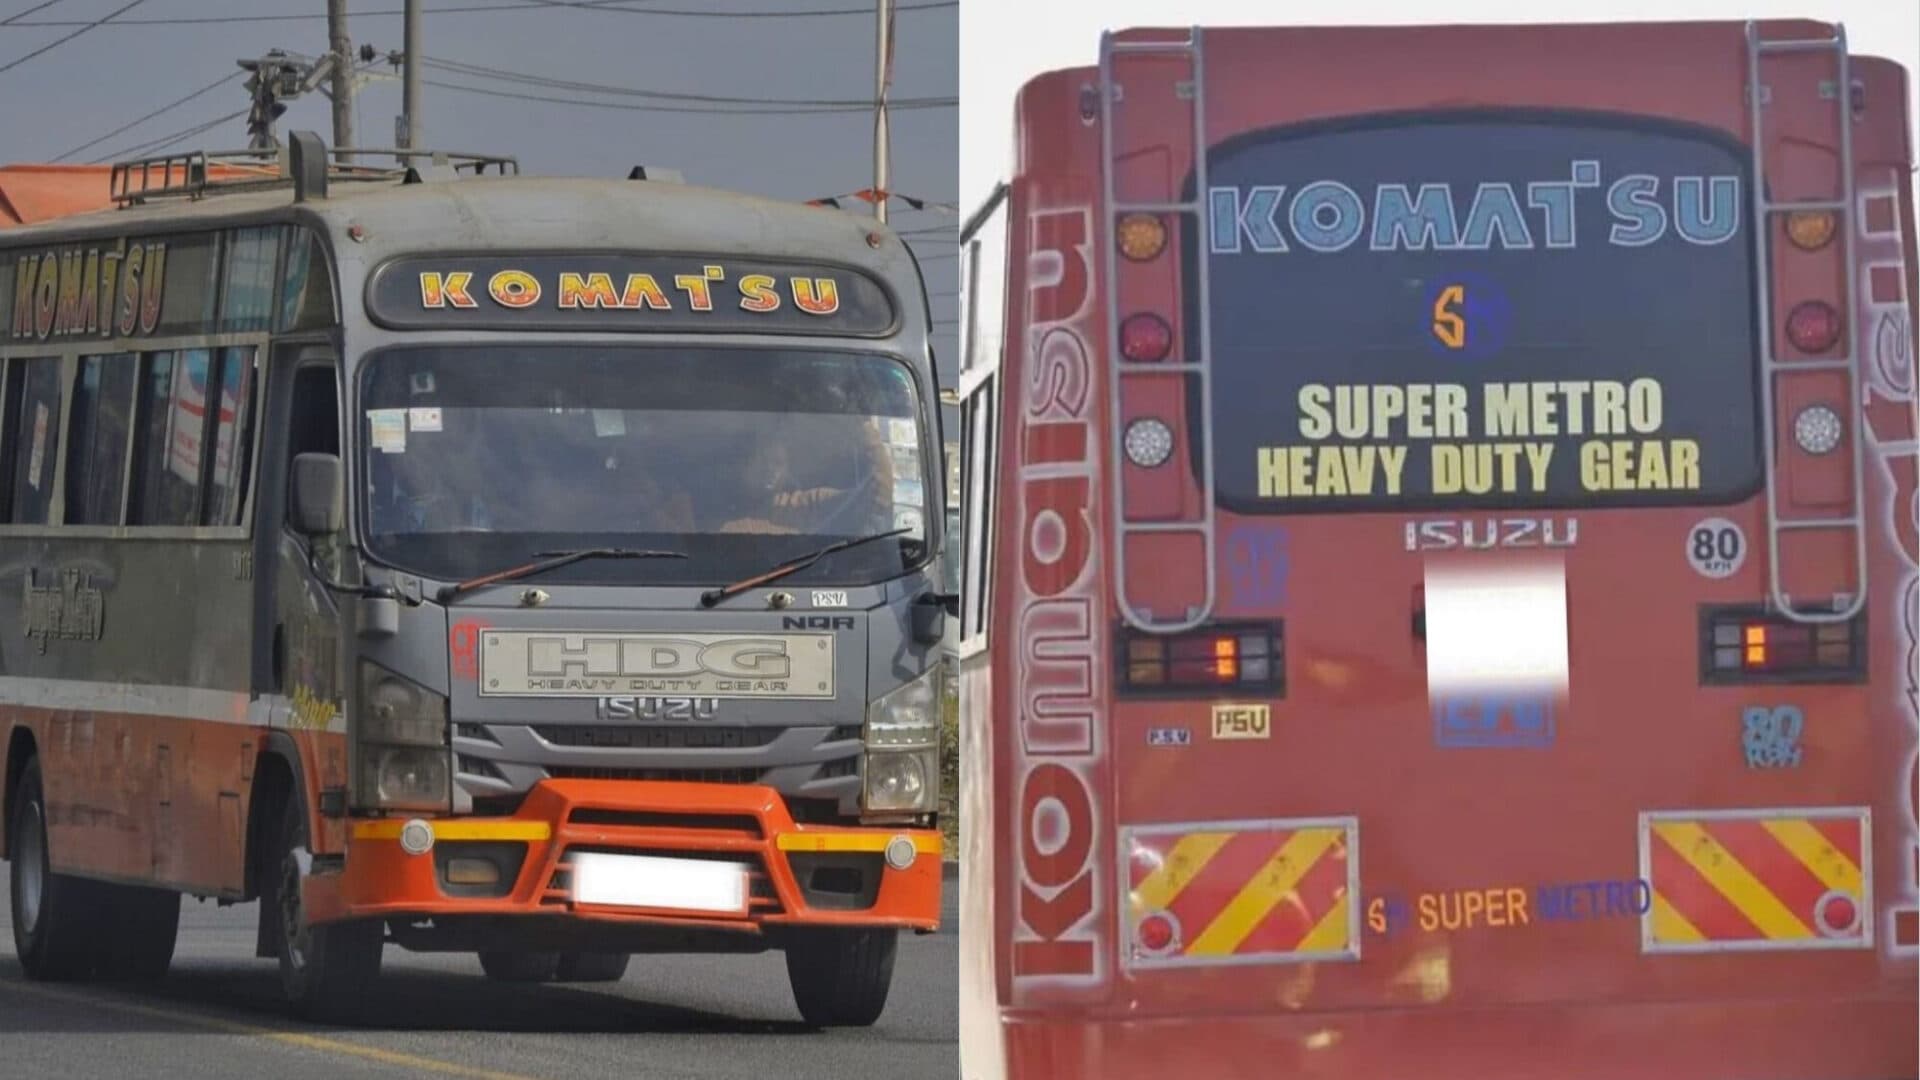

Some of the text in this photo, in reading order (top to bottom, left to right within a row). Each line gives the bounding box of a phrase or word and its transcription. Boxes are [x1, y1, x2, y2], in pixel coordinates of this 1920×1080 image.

[1207, 160, 1741, 255] KOMATSU
[12, 237, 166, 340] KOMATSU
[420, 264, 840, 315] KOMATSU
[1298, 377, 1663, 440] SUPER METRO
[1257, 439, 1701, 498] HEAVY DUTY GEAR
[1404, 517, 1579, 552] ISUZU
[1693, 527, 1740, 561] 80
[782, 615, 855, 631] NQR
[527, 637, 791, 679] HDG
[527, 679, 789, 692] HEAVY DUTY GEAR
[596, 696, 720, 721] ISUZU
[1215, 708, 1267, 735] PSV
[1418, 887, 1529, 932] SUPER
[1535, 879, 1651, 922] METRO
